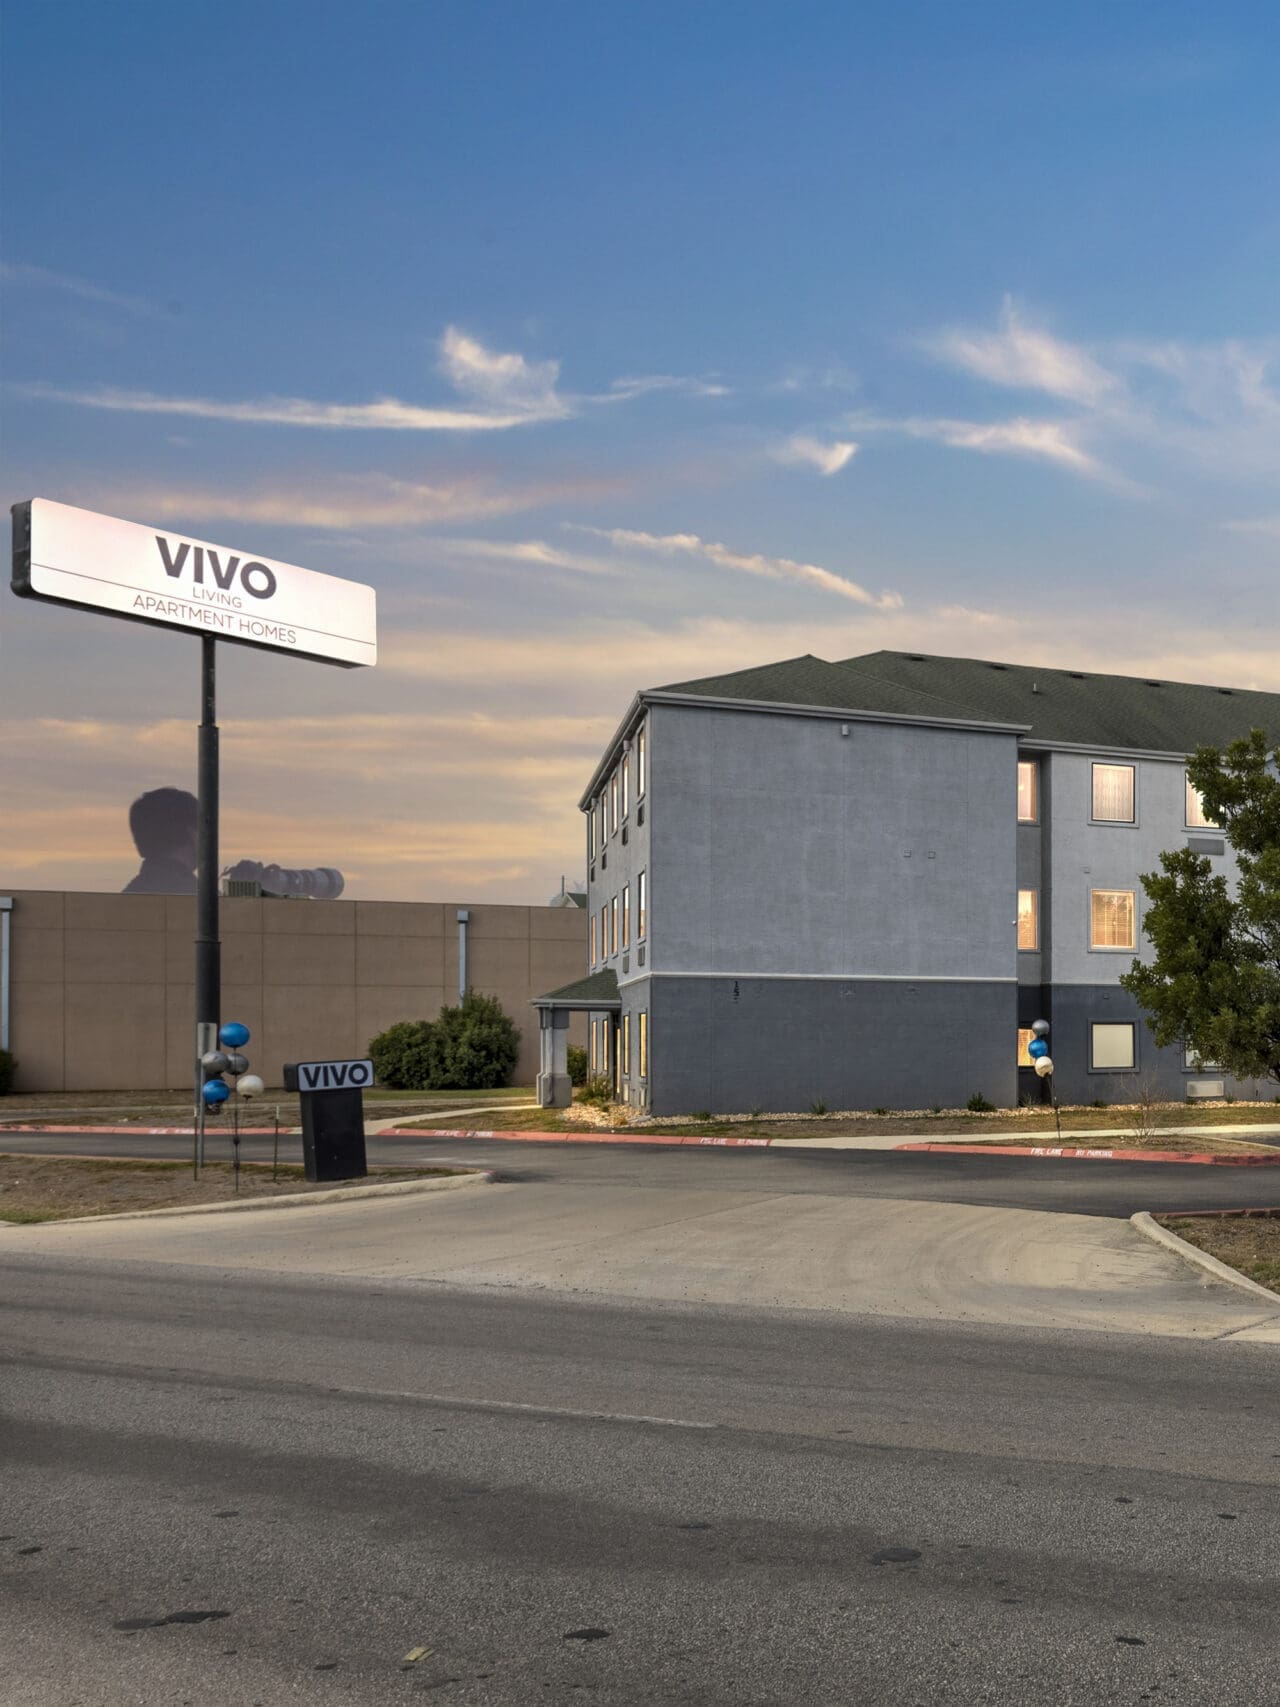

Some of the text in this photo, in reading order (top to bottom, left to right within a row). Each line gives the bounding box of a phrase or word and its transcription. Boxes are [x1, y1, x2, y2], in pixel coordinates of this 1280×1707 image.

[155, 535, 277, 600] VIVO
[192, 586, 243, 609] LIVING
[133, 594, 297, 644] APARTMENT HOMES
[302, 1063, 369, 1088] VIVO
